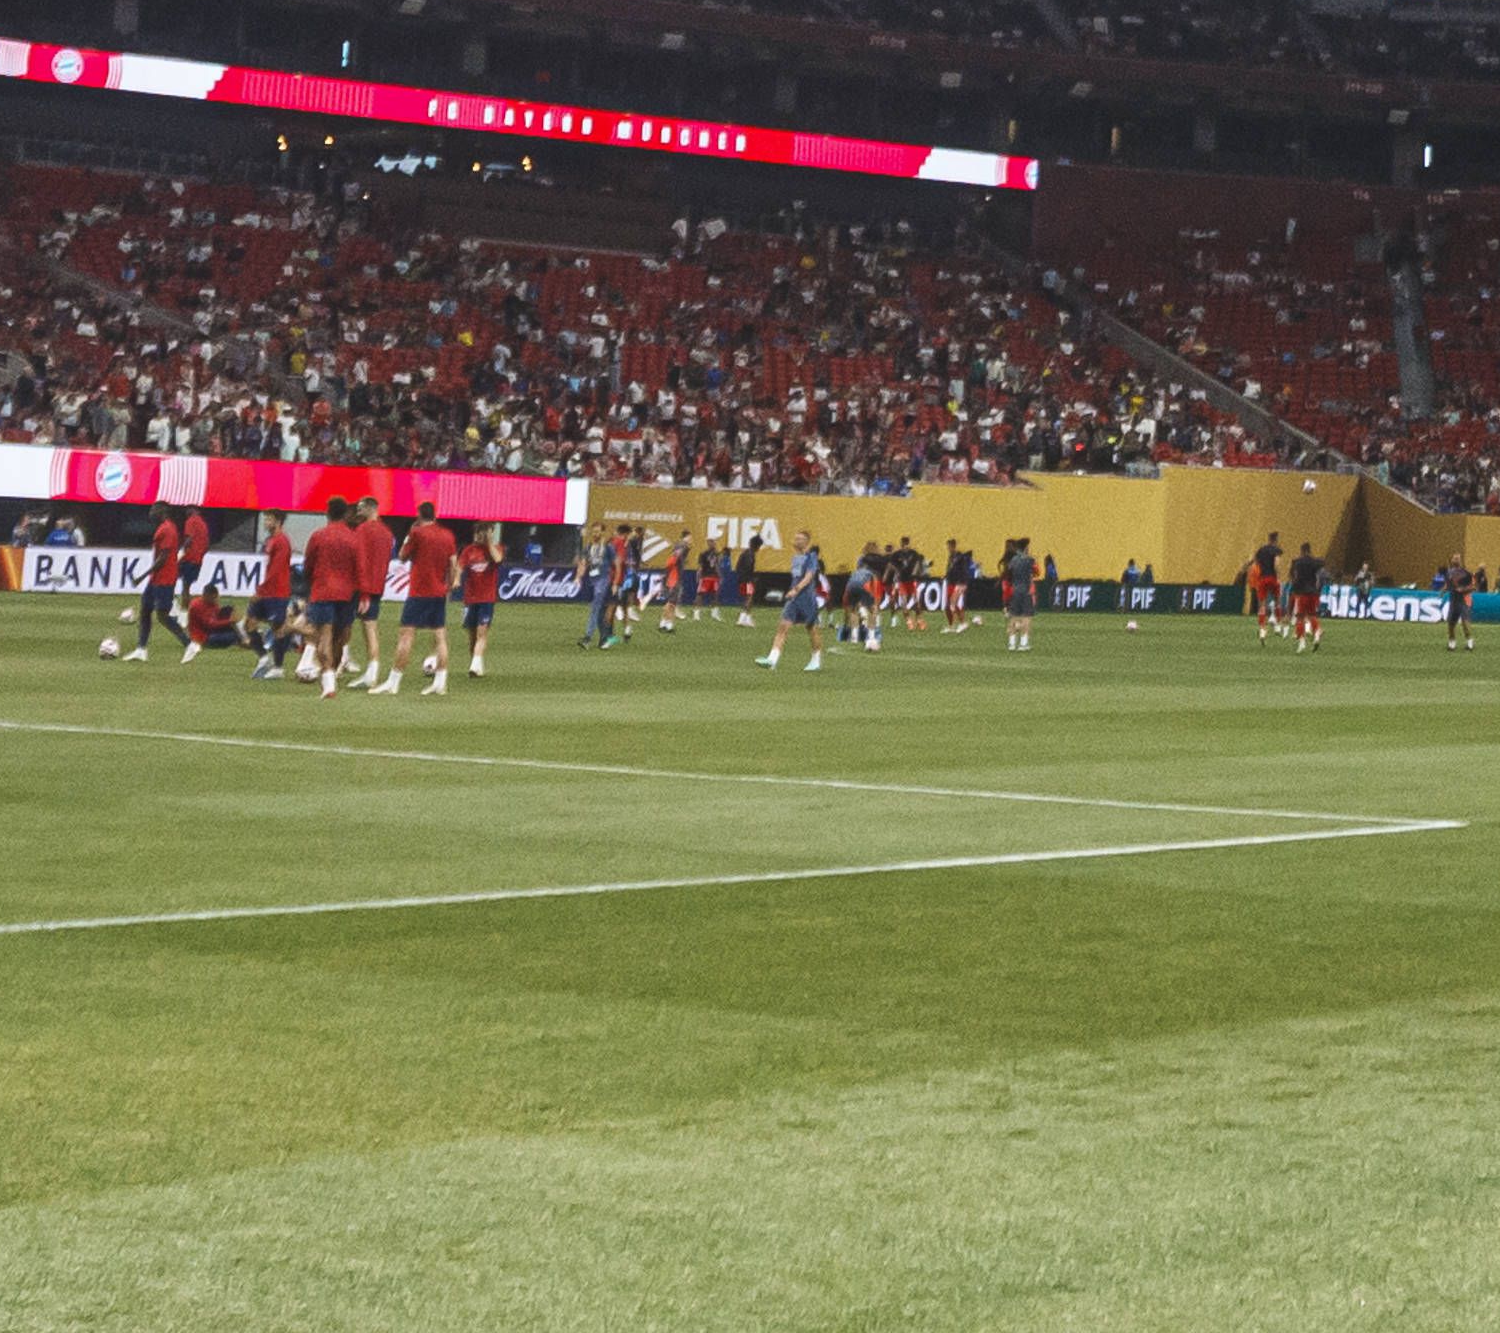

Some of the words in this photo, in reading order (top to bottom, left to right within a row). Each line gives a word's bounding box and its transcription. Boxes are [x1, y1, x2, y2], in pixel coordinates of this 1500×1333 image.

[707, 517, 783, 551] FIFA
[33, 554, 142, 589] BANK
[1066, 587, 1092, 609] PIF
[1130, 587, 1156, 610] PIF
[1192, 587, 1218, 610] PIF
